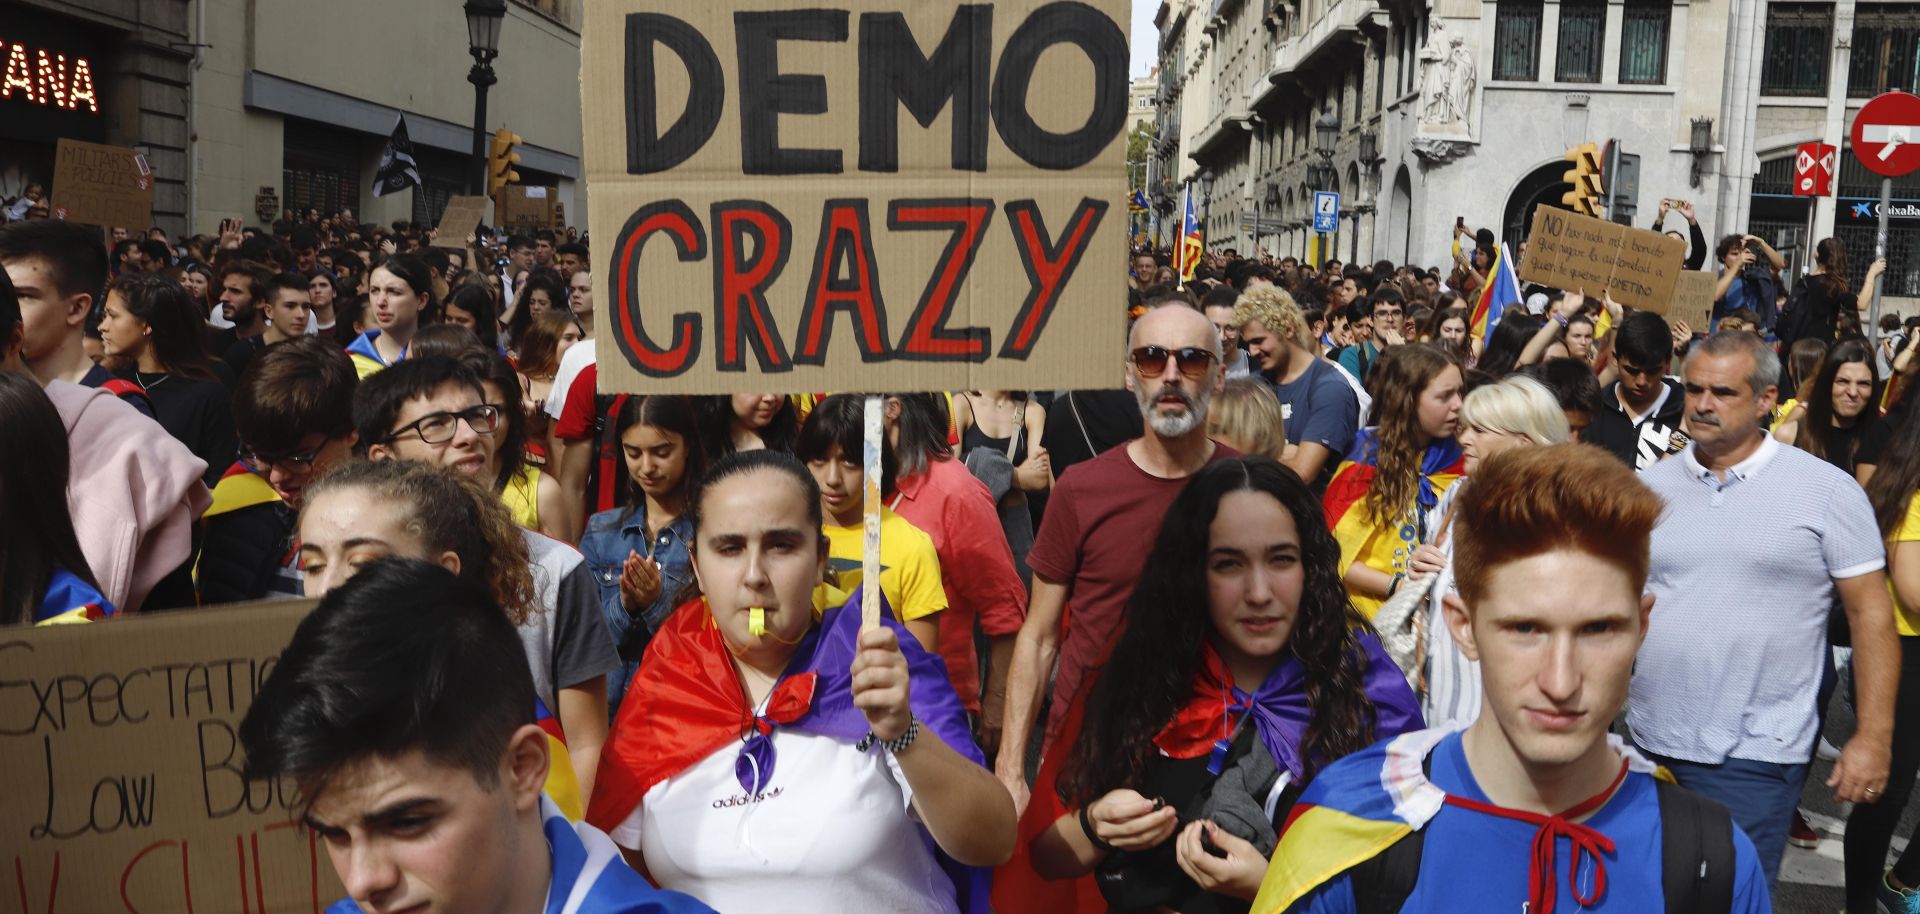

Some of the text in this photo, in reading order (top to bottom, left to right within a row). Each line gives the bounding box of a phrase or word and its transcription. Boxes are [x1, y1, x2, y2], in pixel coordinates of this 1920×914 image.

[0, 41, 99, 113] ANA
[624, 1, 1130, 174] DEMO
[1542, 215, 1563, 237] NO
[608, 196, 1109, 378] CRAZY
[1655, 269, 1664, 278] a
